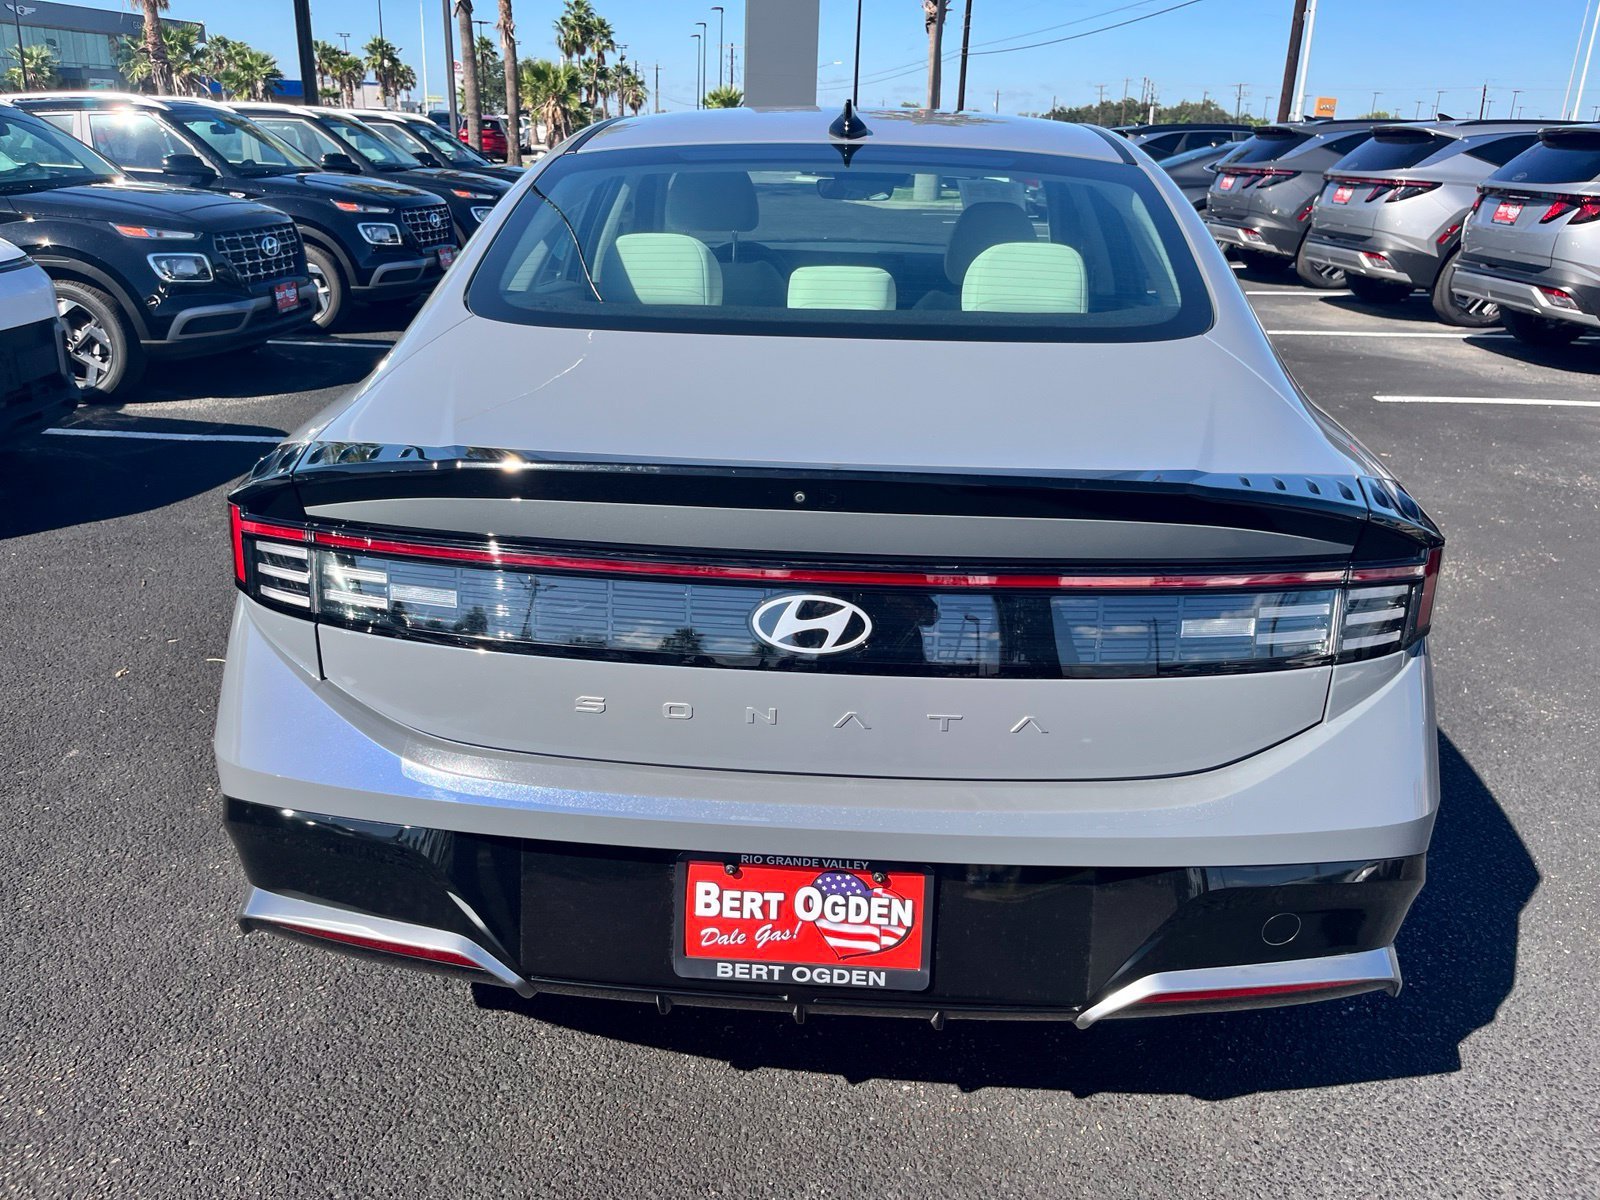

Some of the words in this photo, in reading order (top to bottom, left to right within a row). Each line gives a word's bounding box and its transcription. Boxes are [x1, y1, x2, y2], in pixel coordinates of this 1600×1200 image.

[575, 695, 1049, 734] SONATA
[741, 854, 763, 864] RIO
[766, 856, 819, 868] GRANDE
[822, 859, 869, 870] VALLEY
[694, 881, 785, 921] BERT
[794, 886, 913, 927] OGDEN
[700, 927, 747, 947] Dale
[754, 921, 803, 949] Gas!
[716, 962, 785, 981] BERT
[791, 966, 886, 987] OGDEN
